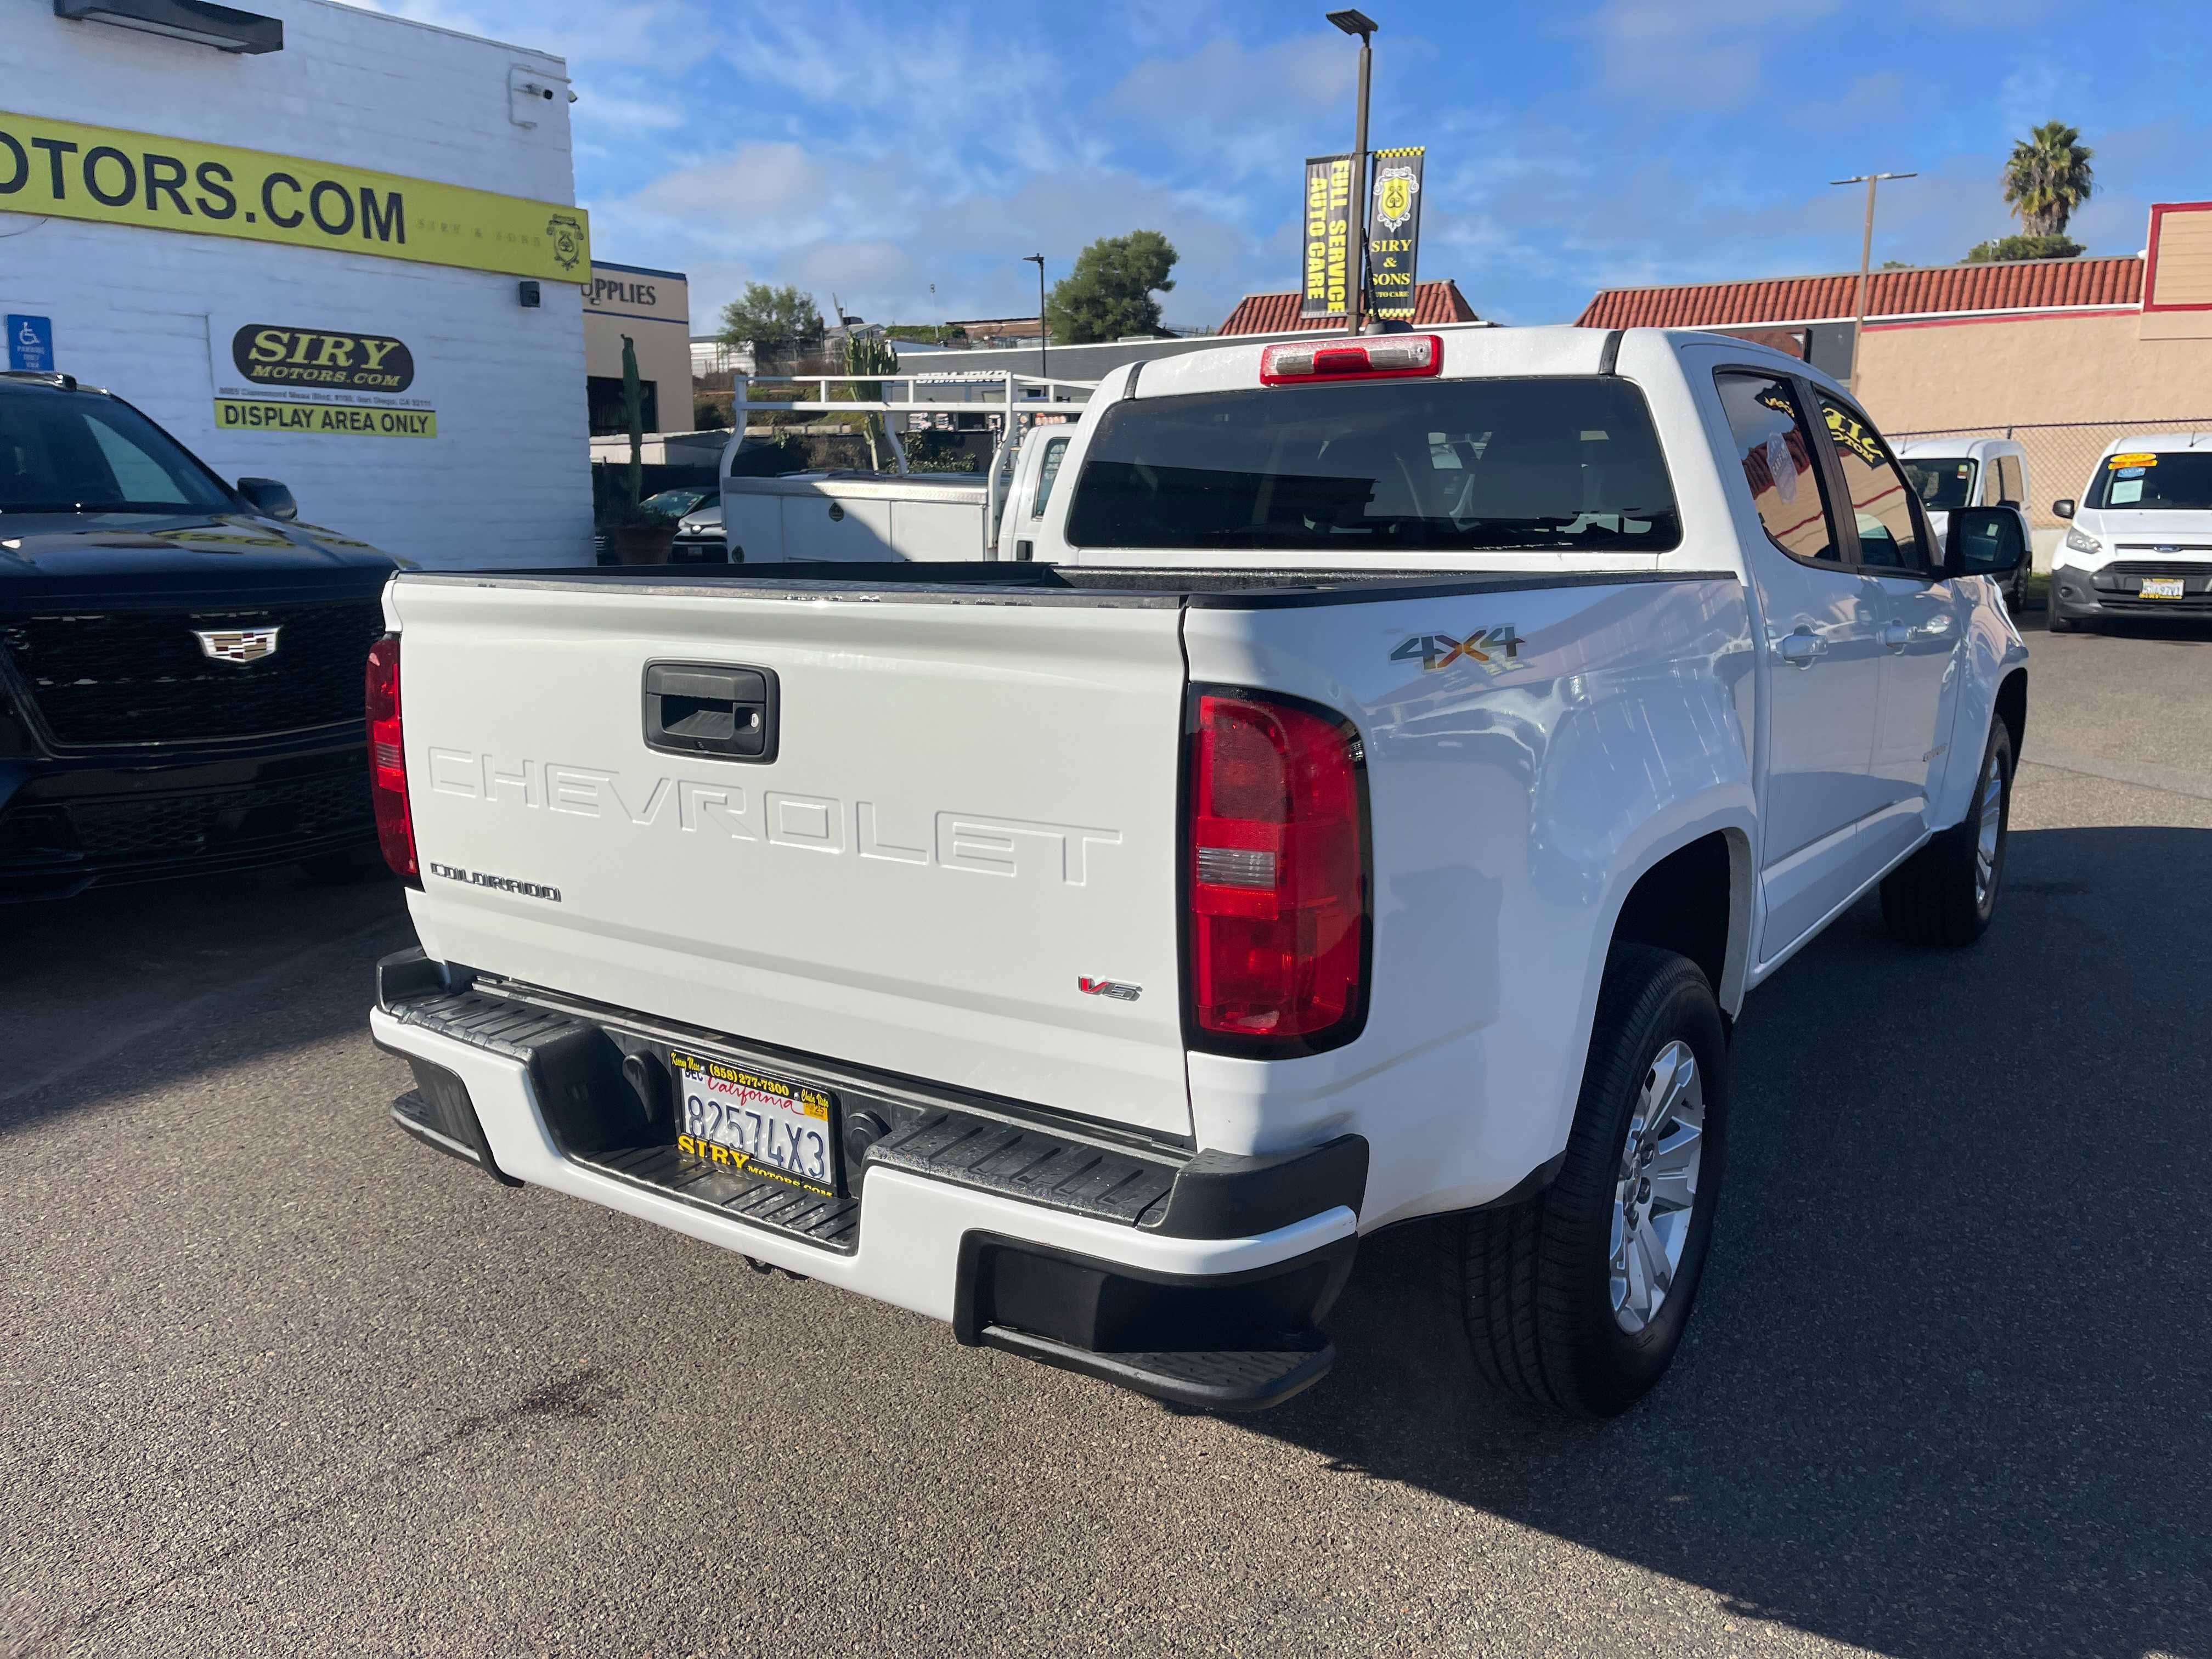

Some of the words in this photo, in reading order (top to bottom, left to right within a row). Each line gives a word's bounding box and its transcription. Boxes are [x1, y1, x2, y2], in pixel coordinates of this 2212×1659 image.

[1329, 160, 1350, 210] FULL
[1308, 177, 1328, 237] AUTO
[1372, 239, 1413, 252] SIRY
[1383, 257, 1397, 268] &
[1307, 242, 1327, 300] CARE
[1327, 219, 1347, 314] SERVICE
[1373, 273, 1411, 286] SONS
[249, 330, 400, 370] SIRY
[251, 364, 400, 387] MOTORS.COM
[224, 404, 314, 428] DISPLAY
[320, 410, 376, 432] AREA
[381, 413, 429, 434] ONLY
[427, 746, 1122, 887] CHEVROLET
[430, 861, 562, 903] COLORADO
[1077, 974, 1143, 1001] V6
[708, 1075, 805, 1115] California
[678, 1134, 751, 1169] SIRY
